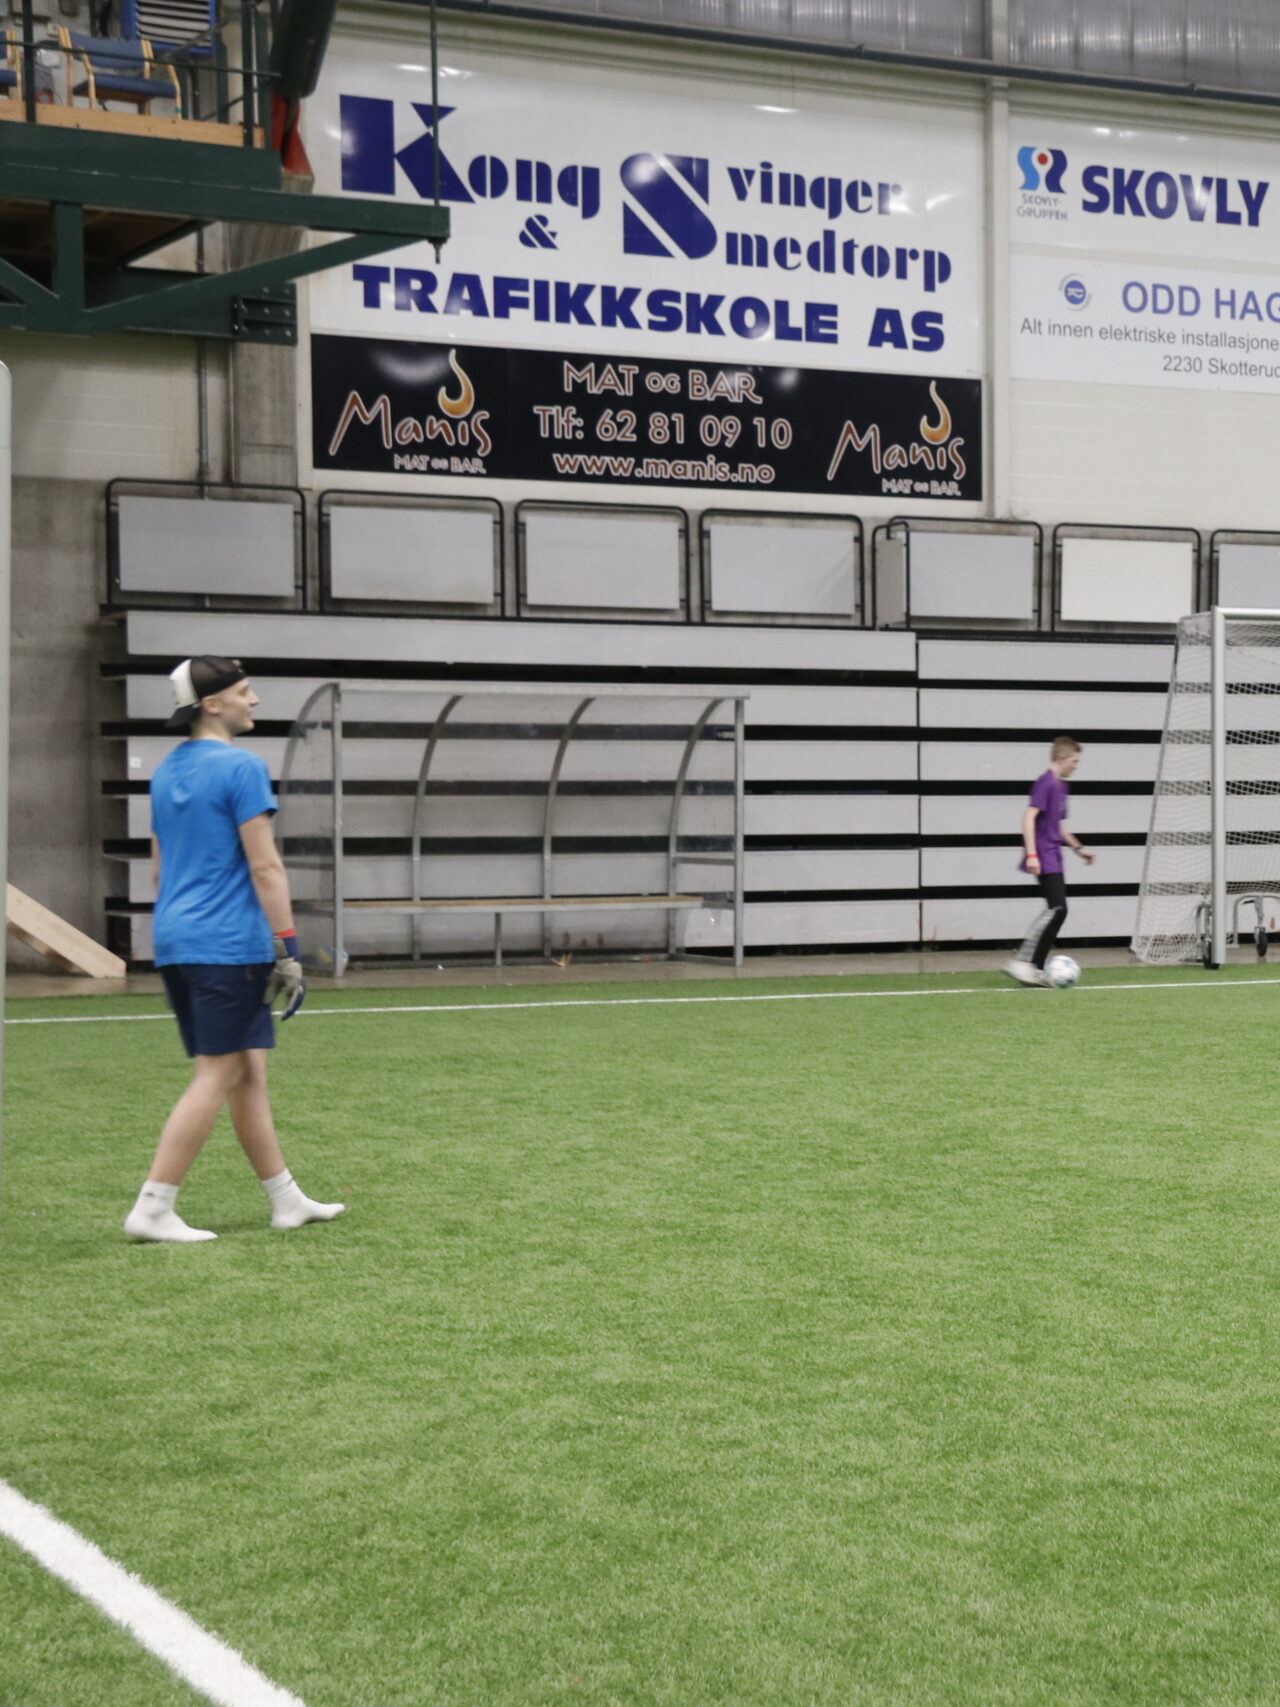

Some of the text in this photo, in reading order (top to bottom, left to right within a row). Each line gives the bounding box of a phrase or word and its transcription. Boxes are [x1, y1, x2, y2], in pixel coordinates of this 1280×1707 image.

[339, 94, 601, 219] Kong
[1017, 206, 1068, 220] GRUPPEN
[1081, 165, 1269, 227] SKOVLY
[518, 214, 559, 250] &
[351, 264, 945, 353] TRAFIKKSKOLE AS
[1121, 281, 1201, 316] ODD
[1020, 317, 1043, 335] Alt
[1048, 320, 1093, 338] innen
[1099, 322, 1176, 344] elektriske
[563, 360, 639, 396] MAT
[689, 369, 763, 404] BAR
[1162, 355, 1203, 373] 2230
[328, 390, 492, 457] Manis
[533, 405, 792, 450] Tlf: 62 81 09 10
[394, 453, 430, 471] MAT
[450, 457, 487, 474] BAR
[553, 453, 775, 484] www.manis.no
[827, 420, 966, 481] Manis
[882, 478, 913, 494] MAT
[930, 480, 961, 496] BAR
